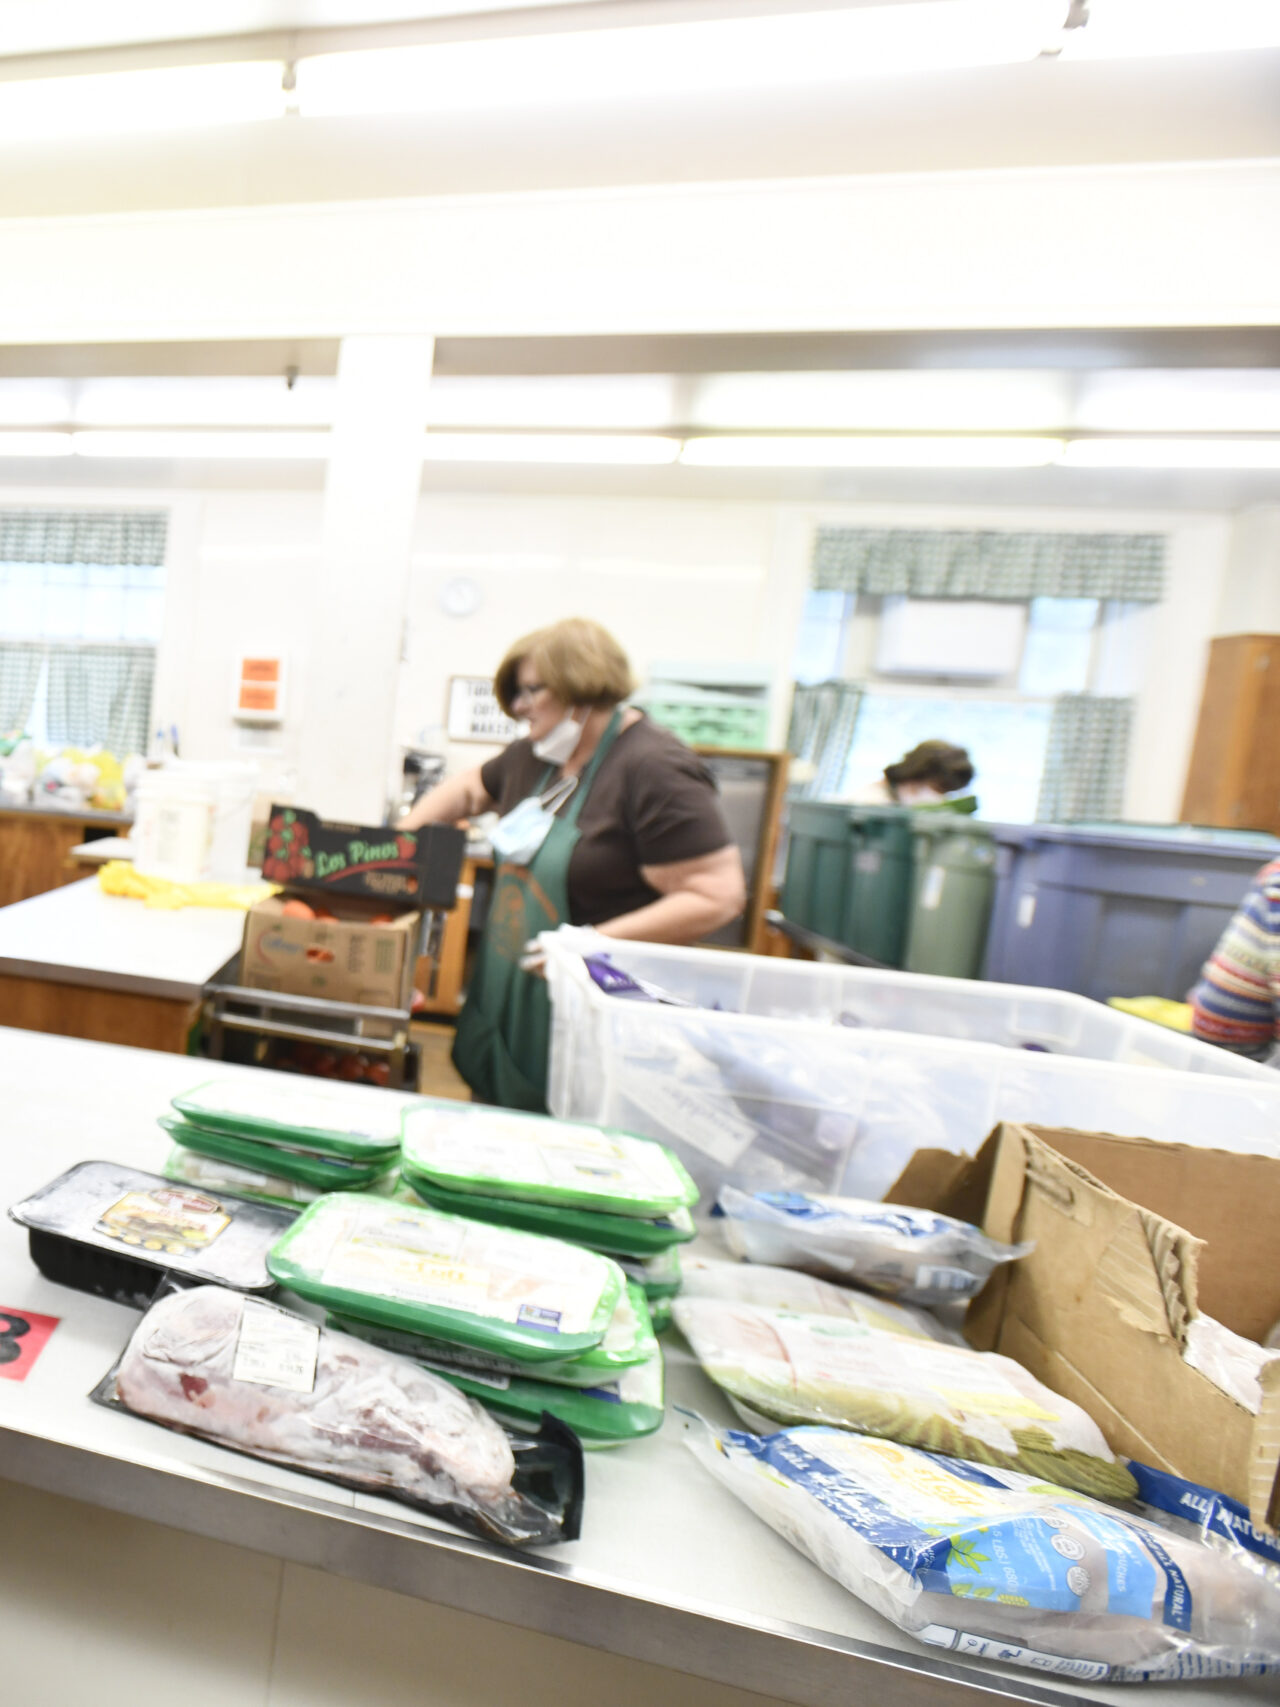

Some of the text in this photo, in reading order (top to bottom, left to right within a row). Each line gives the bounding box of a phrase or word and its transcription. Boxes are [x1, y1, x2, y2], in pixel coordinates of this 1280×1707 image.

[315, 840, 399, 878] Los Pinos
[1167, 1569, 1186, 1617] NATURAL
